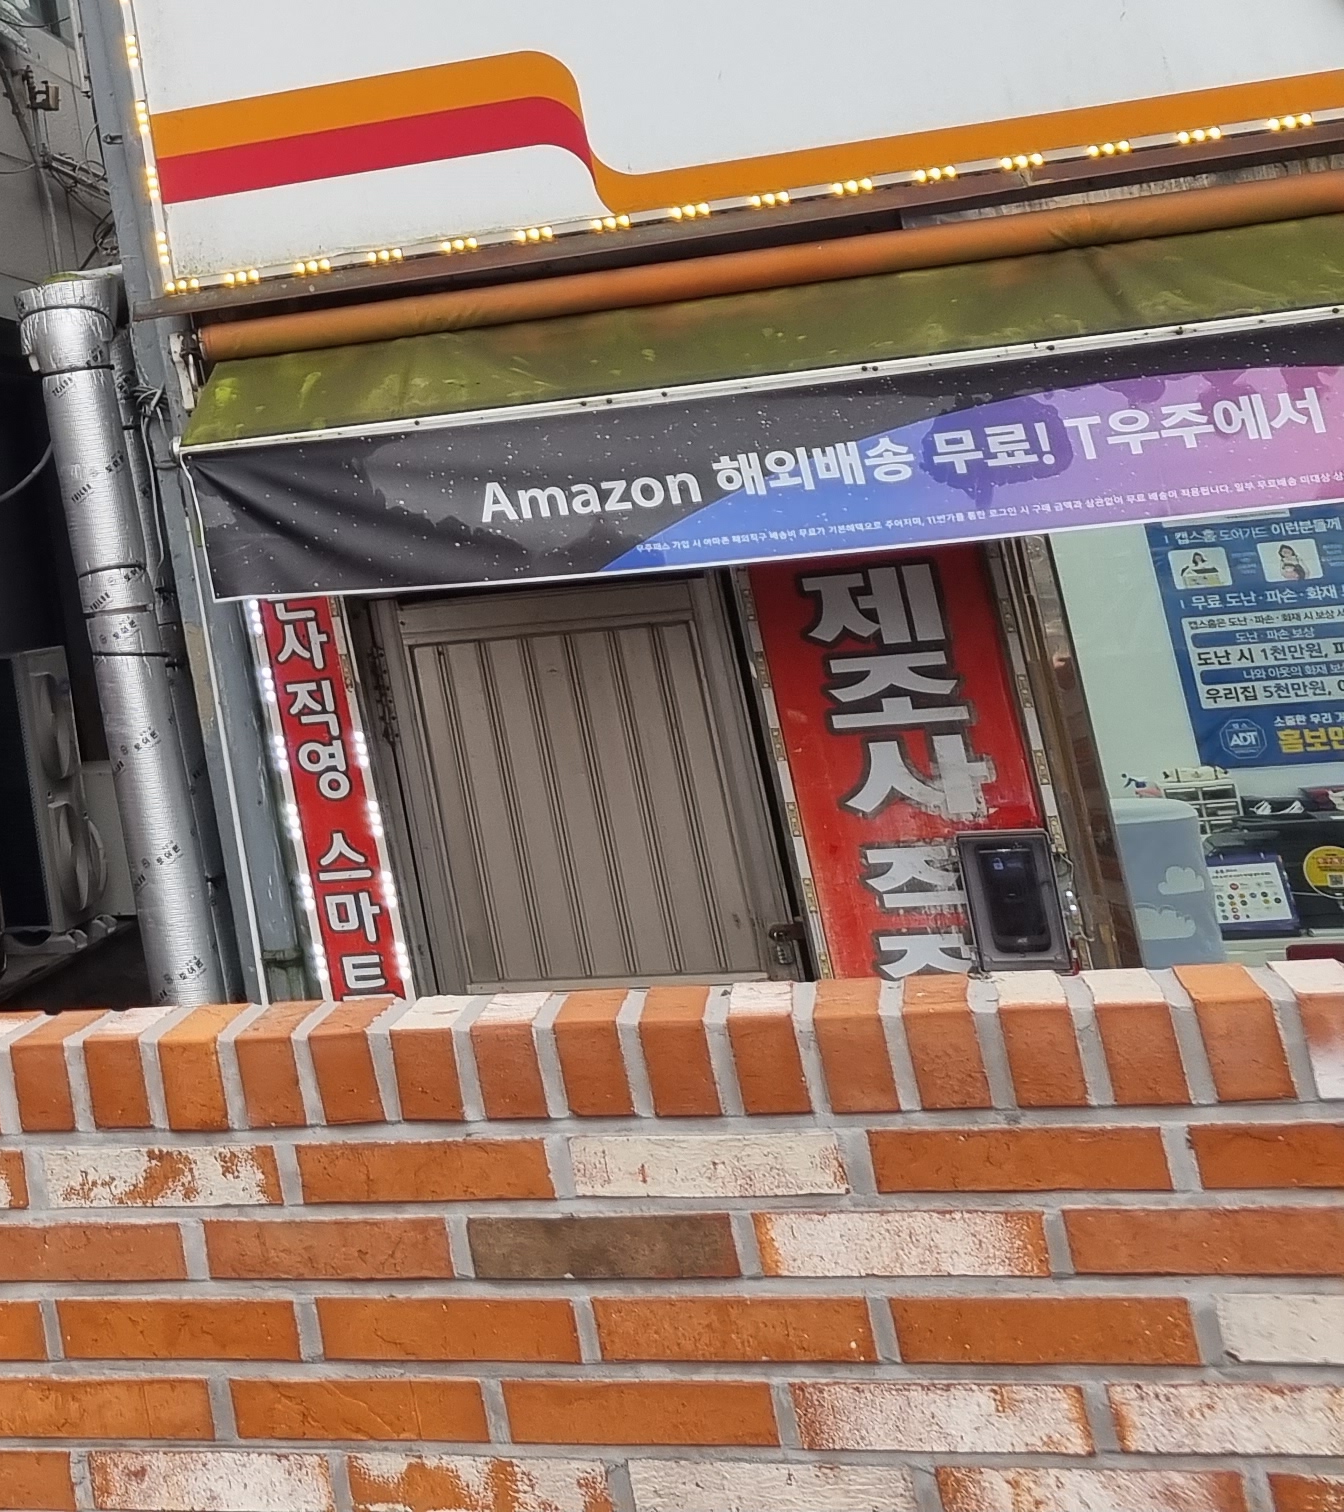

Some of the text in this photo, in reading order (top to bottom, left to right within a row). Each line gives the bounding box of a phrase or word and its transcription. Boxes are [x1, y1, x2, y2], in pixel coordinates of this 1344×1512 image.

[481, 387, 1327, 523] Amazon 해외배송 무료! T우주에서
[1219, 527, 1269, 541] 도어가드
[1191, 594, 1224, 610] 무료
[1292, 627, 1315, 638] 보상
[1197, 650, 1232, 666] 도난
[1237, 648, 1255, 663] 시
[1260, 642, 1328, 661] 1천만원,
[1243, 663, 1344, 679] 나와 이웃의 화재 보
[1206, 685, 1258, 704] 우리집
[1264, 680, 1332, 699] 5천만원,
[1310, 712, 1332, 724] 우리
[286, 680, 352, 800] 직영
[1230, 731, 1258, 746] ADT
